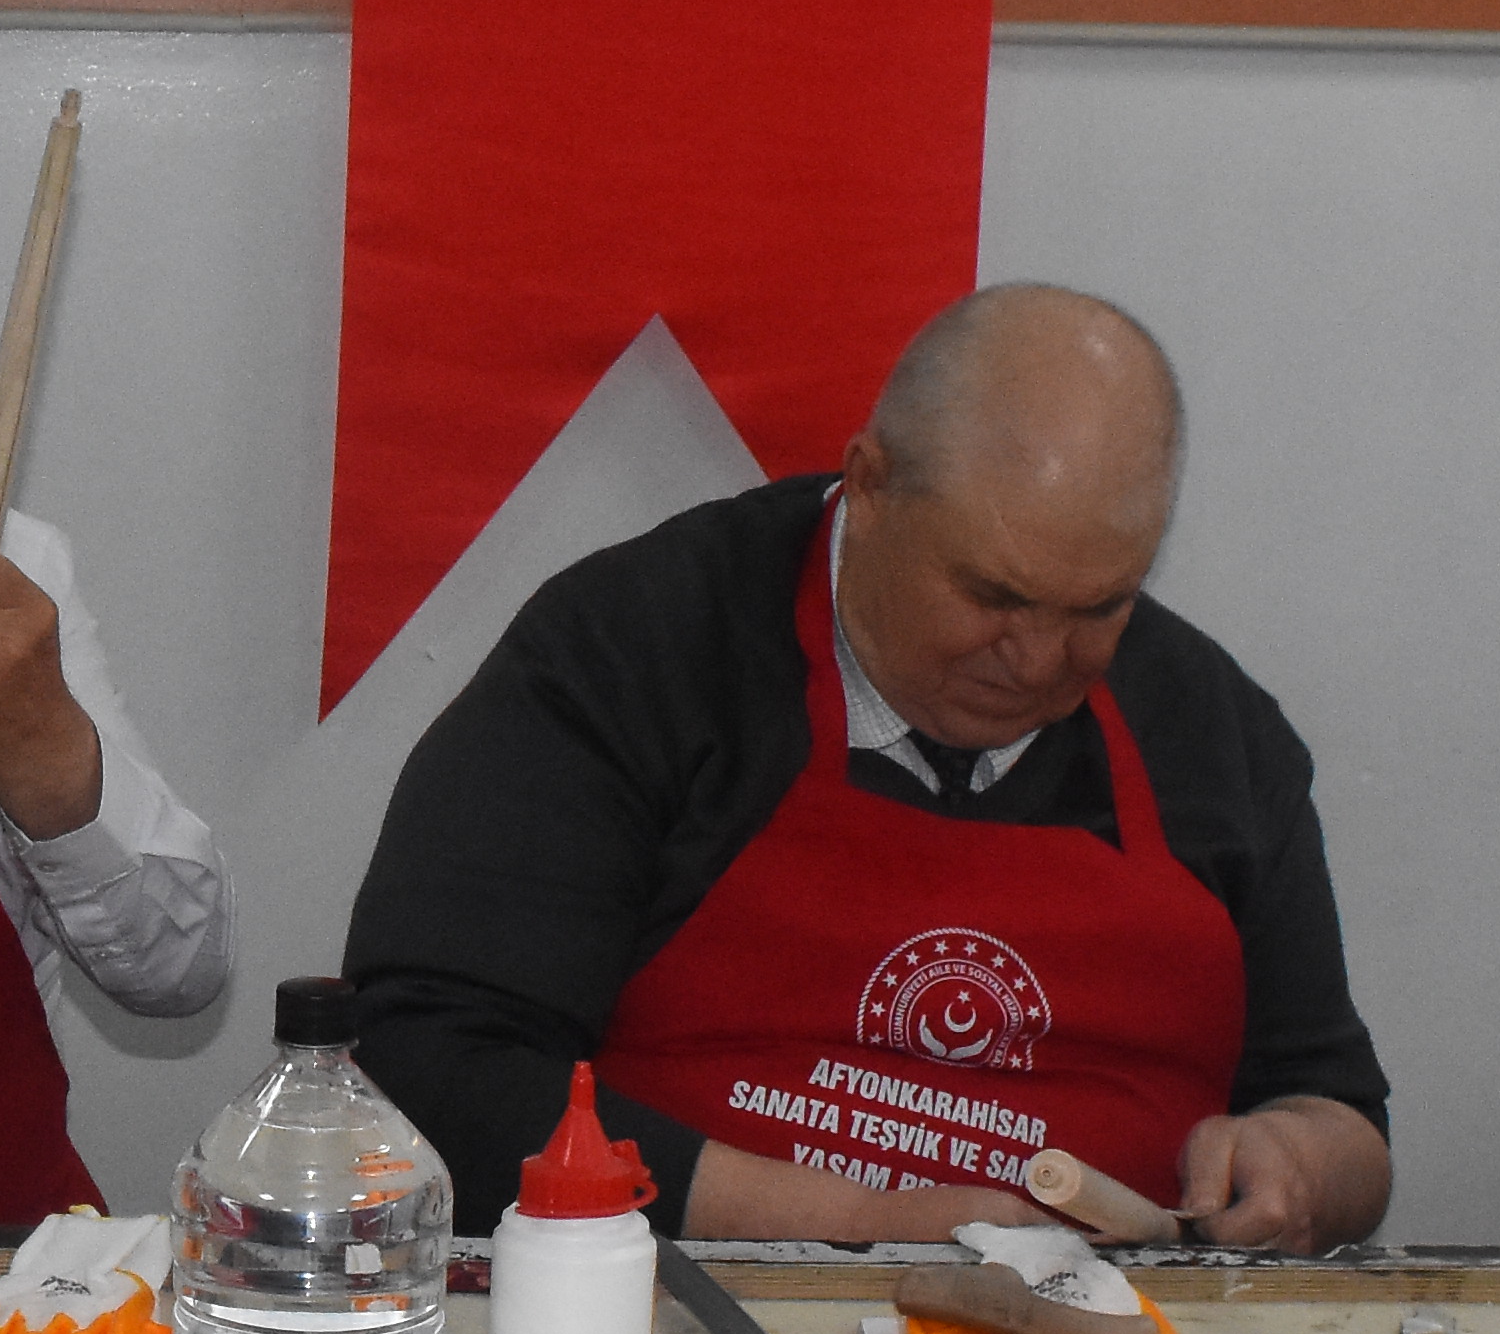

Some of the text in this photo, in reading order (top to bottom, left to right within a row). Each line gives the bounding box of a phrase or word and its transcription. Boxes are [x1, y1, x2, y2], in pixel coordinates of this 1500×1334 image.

[952, 963, 966, 974] VE
[968, 965, 1002, 996] SOSYAL
[728, 1080, 841, 1135] SANATA
[849, 1109, 945, 1162] TEŞVİK
[949, 1136, 983, 1173] VE
[808, 1057, 1048, 1148] AFYONKARAHİSAR
